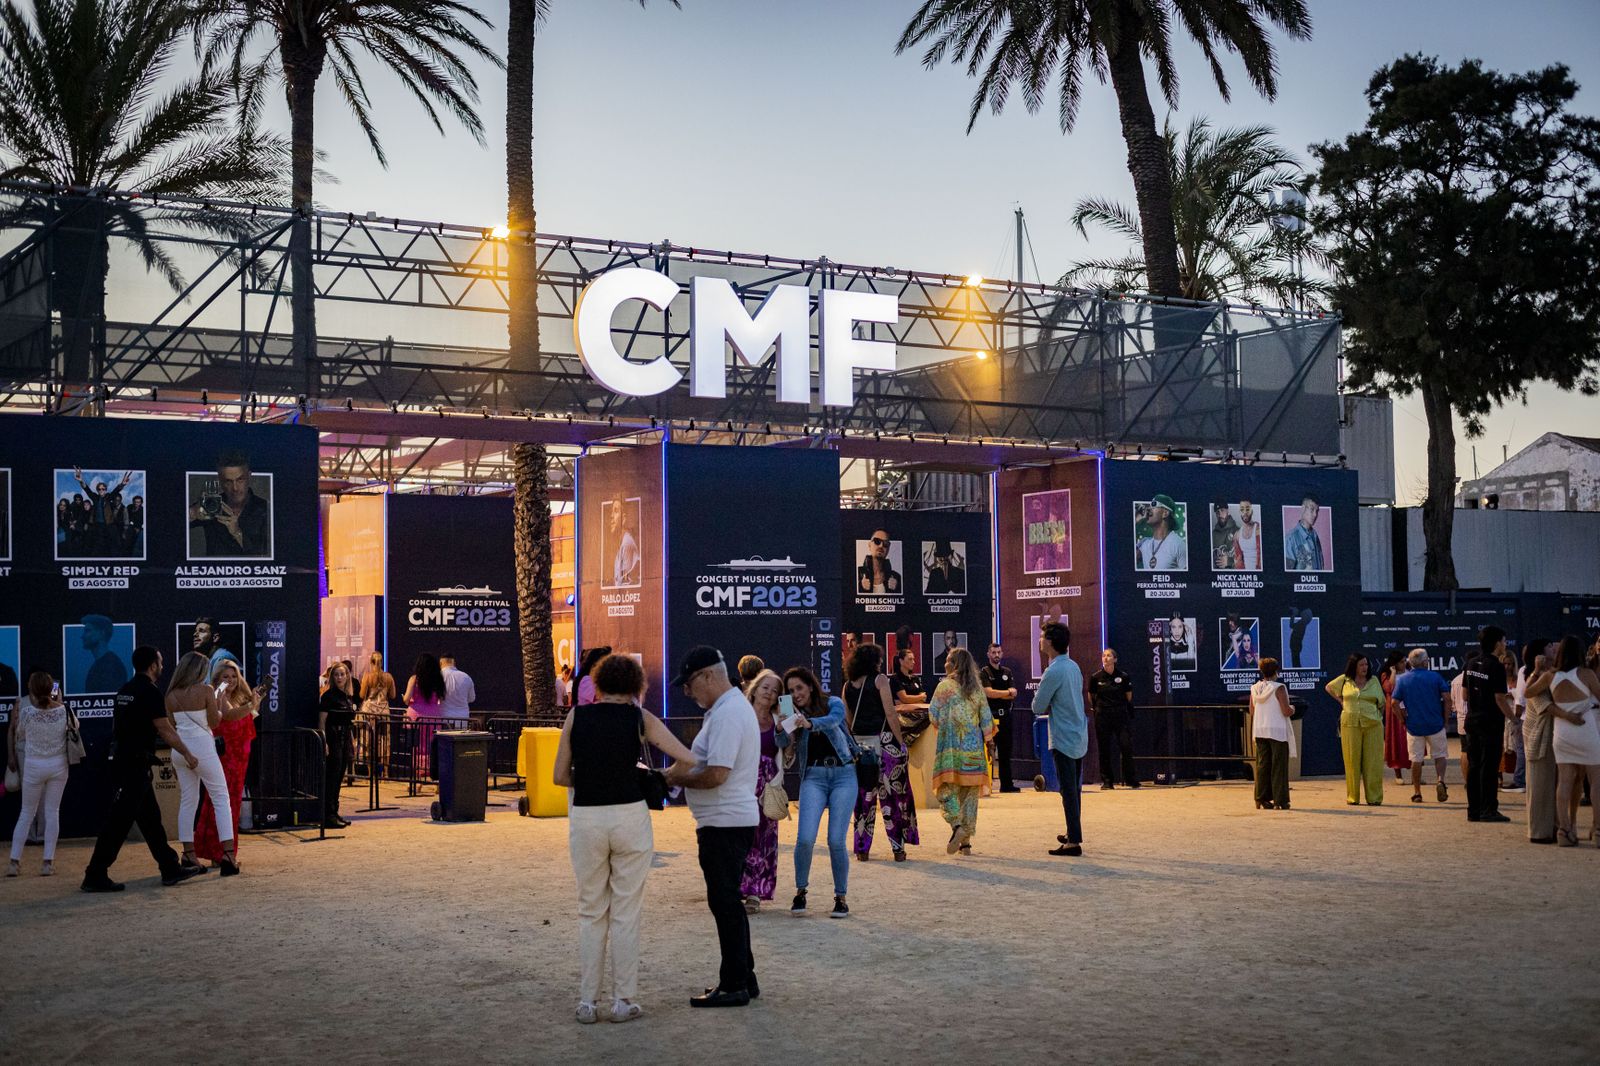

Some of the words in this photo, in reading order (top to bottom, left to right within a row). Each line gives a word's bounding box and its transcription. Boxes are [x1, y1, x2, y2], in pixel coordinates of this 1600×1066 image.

[573, 267, 899, 407] CMF
[61, 566, 110, 576] SIMPLY
[113, 566, 140, 576] RED
[174, 566, 252, 576] ALEJANDRO
[254, 566, 287, 575] SANZ
[1036, 576, 1061, 586] BRESH
[1152, 574, 1171, 583] FEID
[1300, 575, 1319, 583] DUKI
[1211, 581, 1239, 589] MANUEL
[1059, 587, 1080, 595] AGOSTO
[601, 594, 621, 604] PABLO
[855, 597, 877, 605] ROBIN
[878, 597, 905, 605] SCHULZ
[821, 649, 832, 693] PISTA
[1153, 645, 1162, 694] GRADA
[269, 651, 280, 712] GRADA
